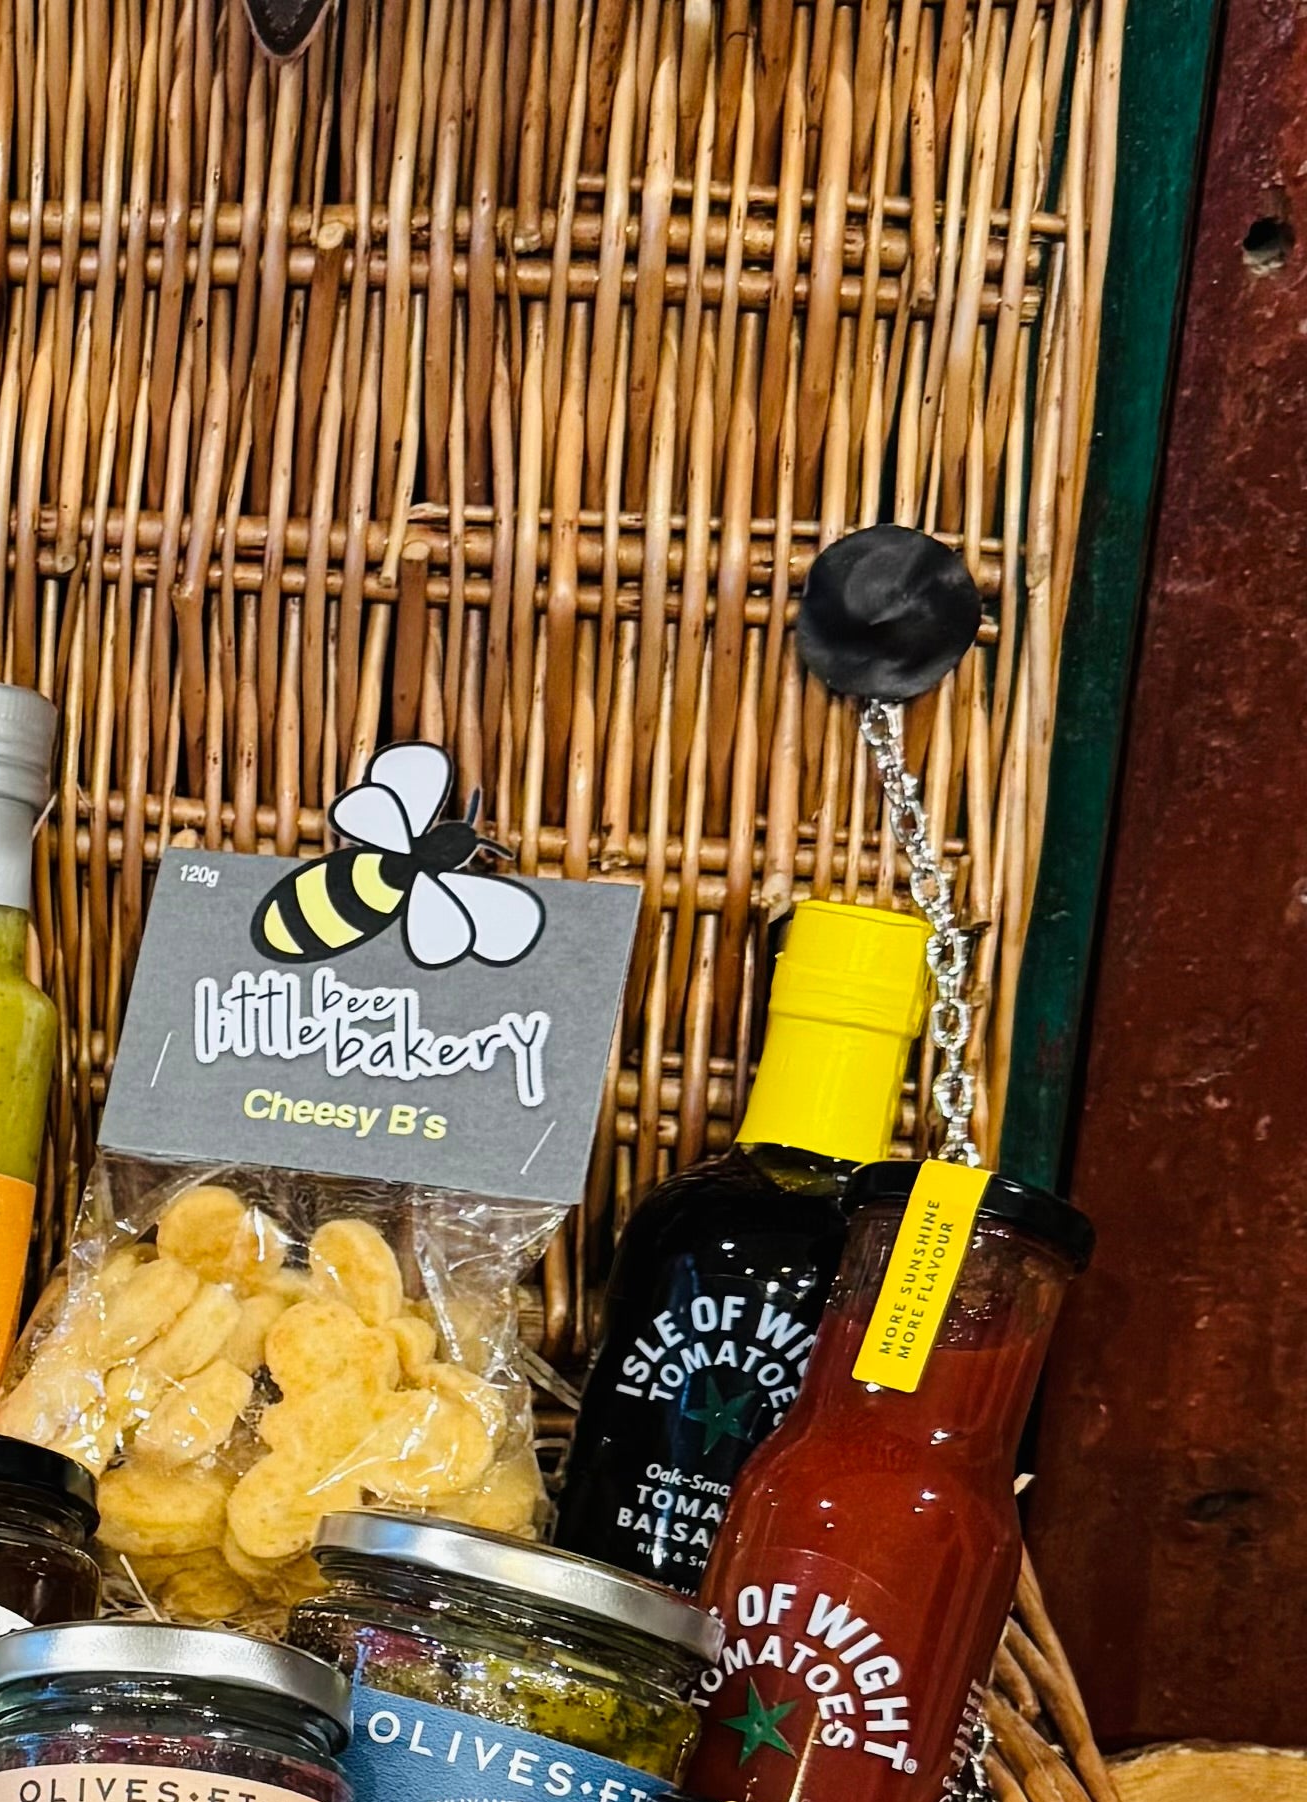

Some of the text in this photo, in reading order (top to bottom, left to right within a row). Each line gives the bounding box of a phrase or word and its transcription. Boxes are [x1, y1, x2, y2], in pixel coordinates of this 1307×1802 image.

[179, 864, 219, 888] 120g
[314, 969, 400, 1019] bee
[195, 970, 550, 1107] little bakery
[242, 1088, 380, 1138] Cheesy
[879, 1198, 942, 1356] MORE SUNSHINE
[896, 1220, 956, 1360] MORE FLAVOUR
[738, 1583, 798, 1627] OF
